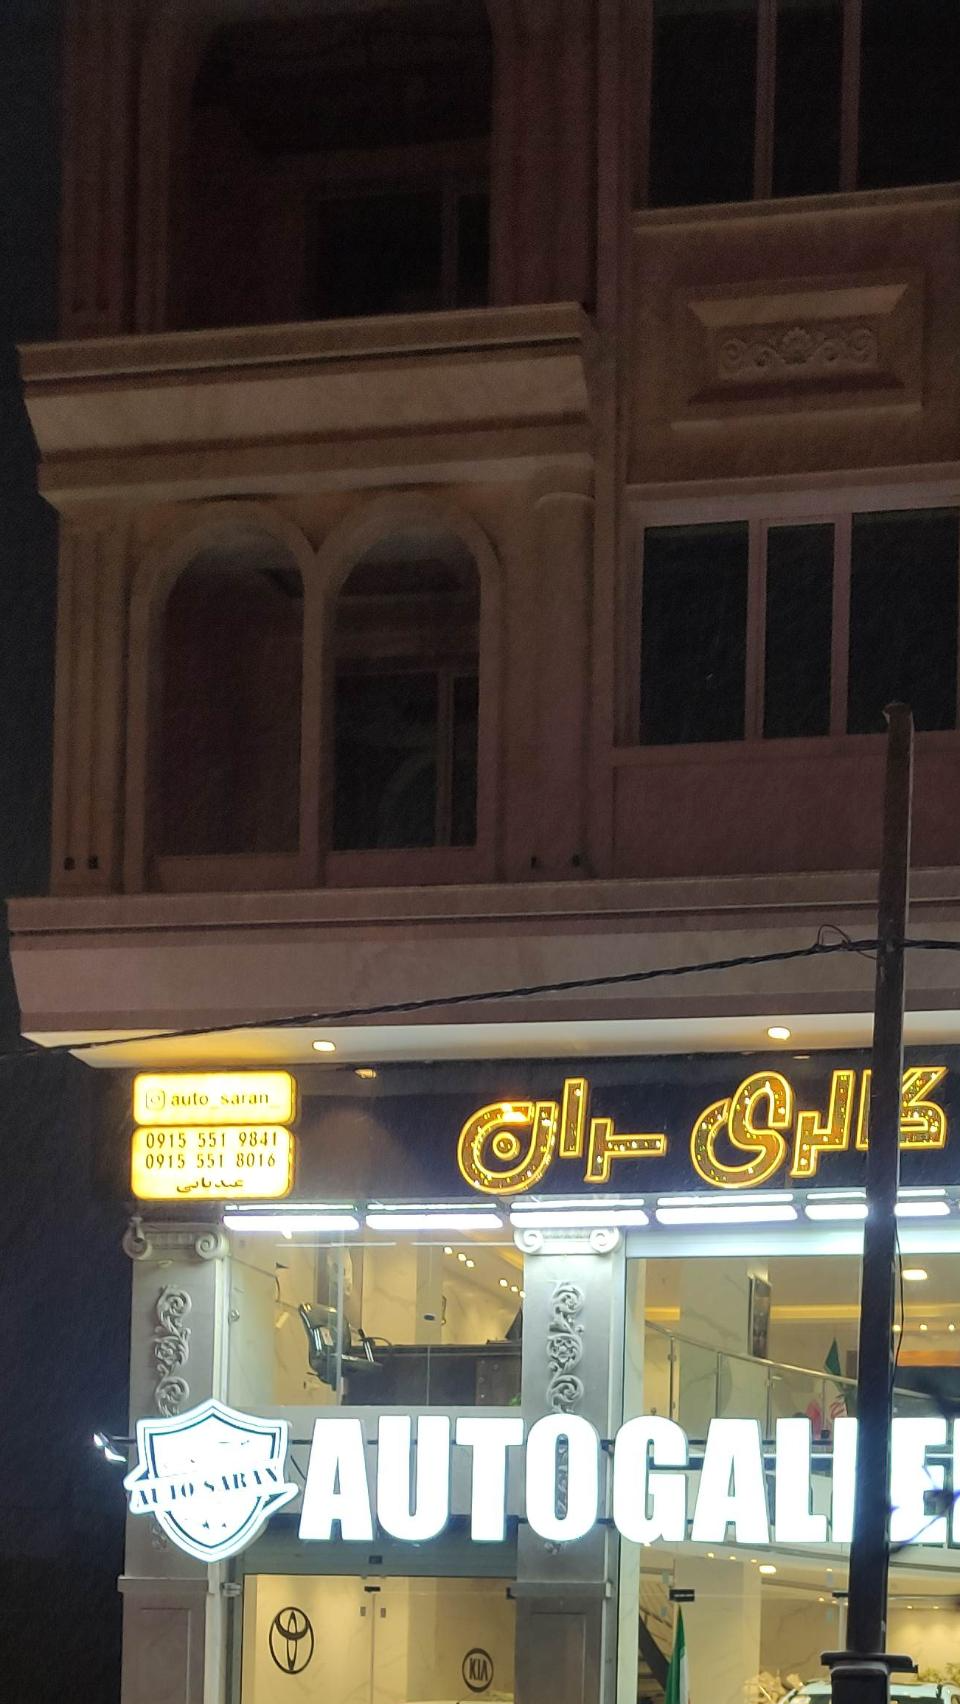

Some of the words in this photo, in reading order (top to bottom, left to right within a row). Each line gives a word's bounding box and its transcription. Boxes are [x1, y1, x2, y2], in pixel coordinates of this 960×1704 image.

[145, 1131, 187, 1149] 0915
[197, 1131, 226, 1148] 551
[238, 1130, 278, 1147] 9841
[456, 1076, 669, 1196] سران
[144, 1152, 186, 1170] 0915
[195, 1152, 224, 1169] 551
[235, 1151, 277, 1168] 8016
[468, 1656, 489, 1681] KIA
